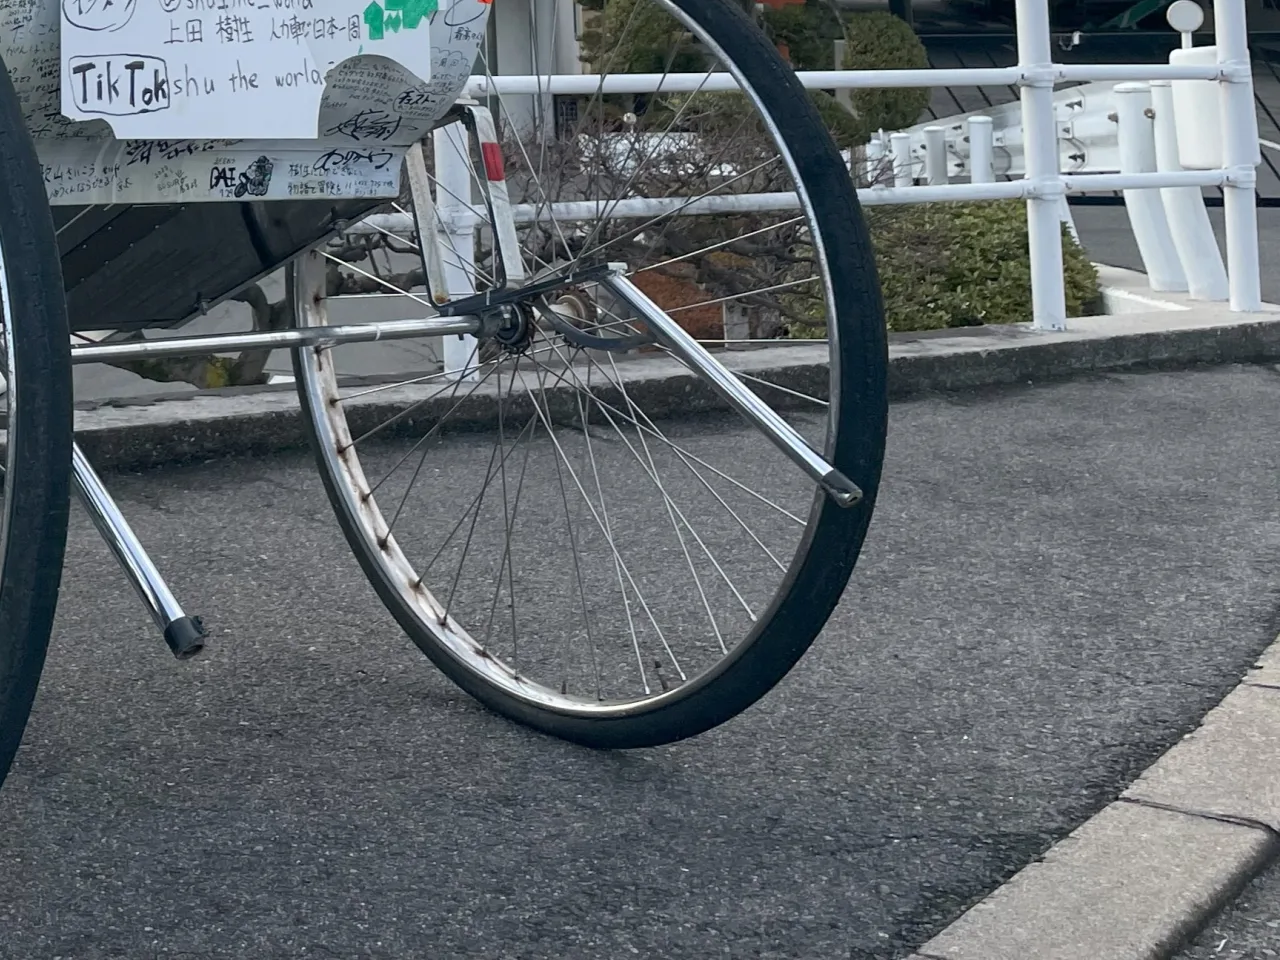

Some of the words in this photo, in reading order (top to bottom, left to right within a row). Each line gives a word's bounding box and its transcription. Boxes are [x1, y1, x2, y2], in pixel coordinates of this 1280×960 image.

[164, 16, 204, 44] 上田
[73, 59, 168, 108] TikTok
[174, 63, 216, 97] shu
[229, 60, 259, 90] the
